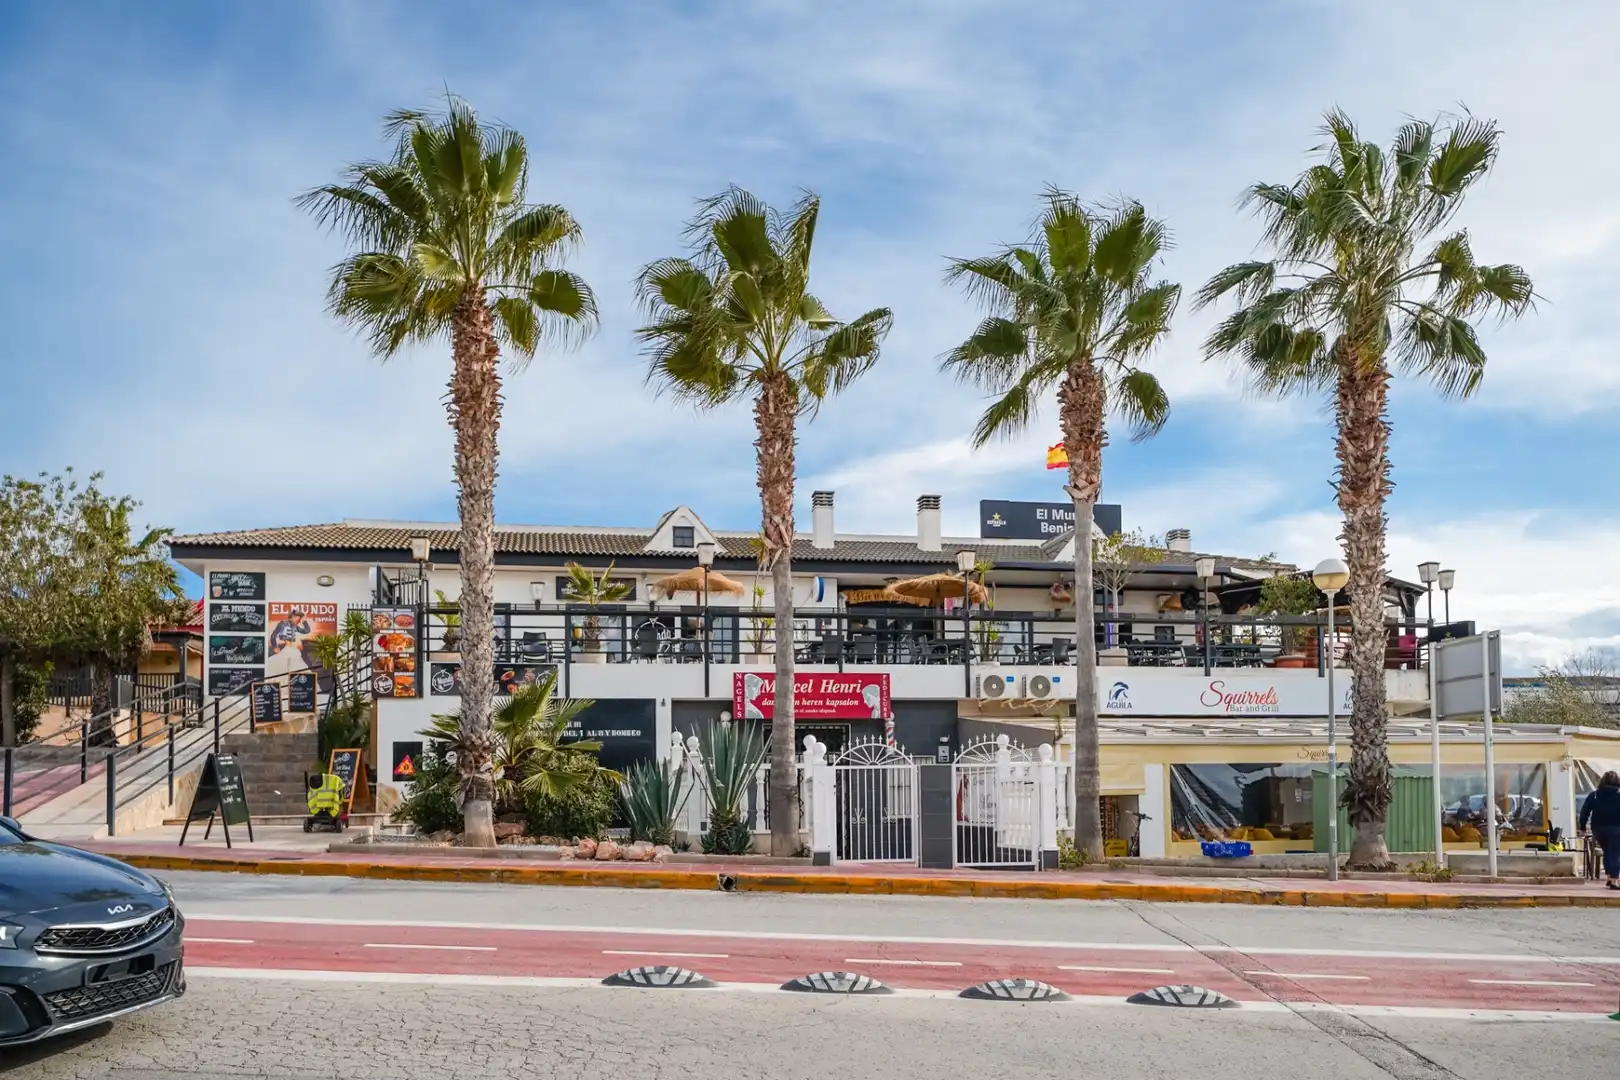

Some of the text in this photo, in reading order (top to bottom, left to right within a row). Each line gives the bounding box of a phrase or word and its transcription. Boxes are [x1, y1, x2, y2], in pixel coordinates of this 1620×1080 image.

[1036, 508, 1048, 520] El
[271, 603, 335, 615] EL MUNDO
[761, 679, 862, 694] Mcel Henri
[735, 673, 743, 718] NAGELS
[1200, 680, 1279, 712] Squirrels
[802, 698, 823, 706] heren
[826, 698, 859, 708] kapsalon
[1230, 704, 1279, 713] Bar and Grill
